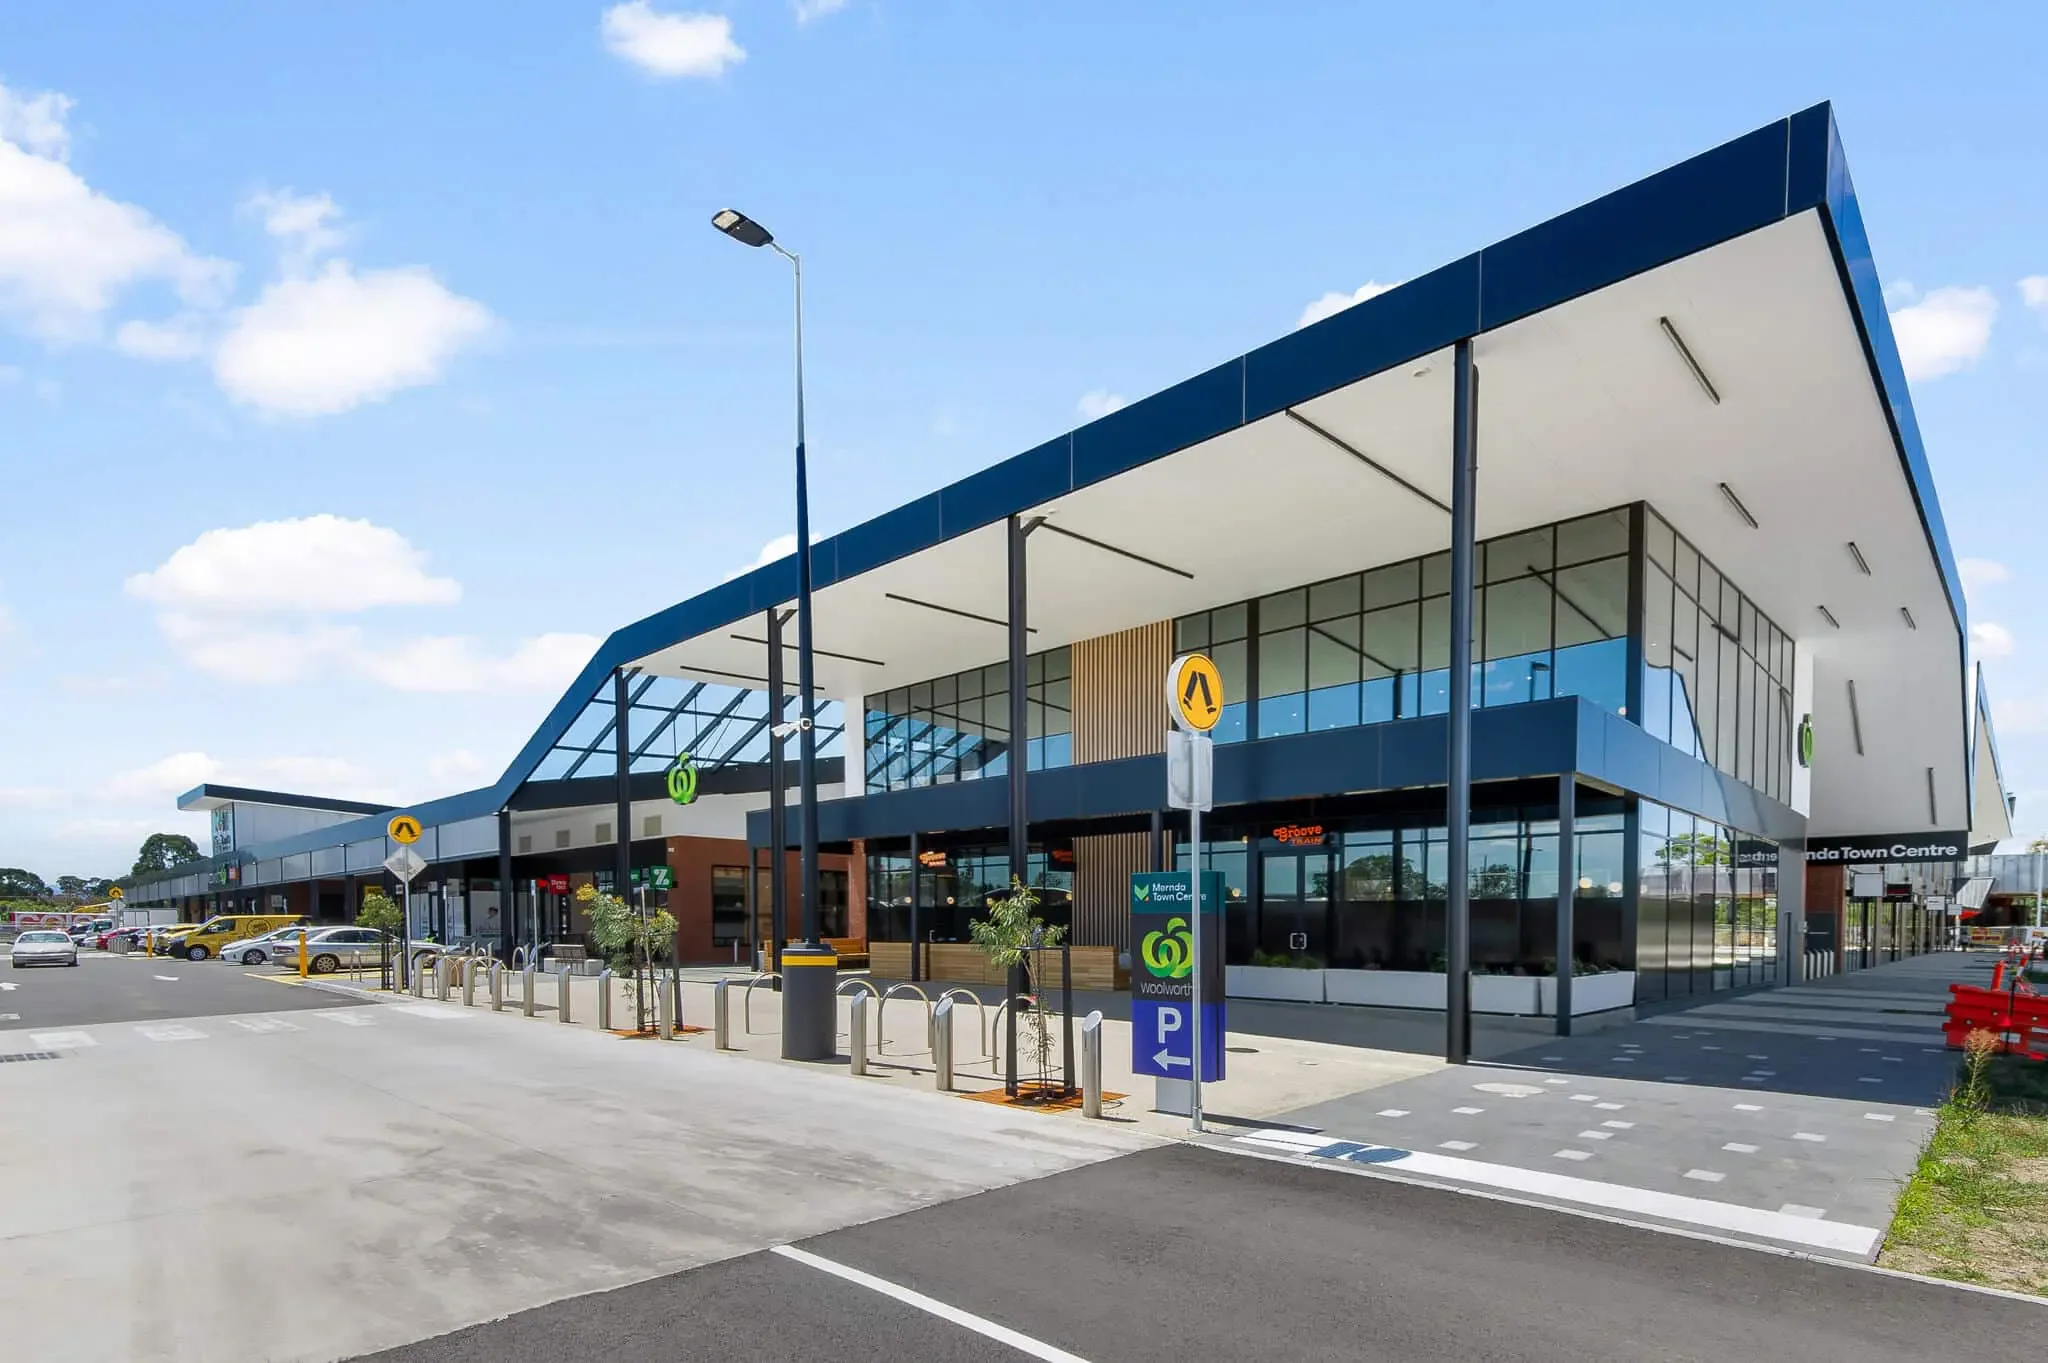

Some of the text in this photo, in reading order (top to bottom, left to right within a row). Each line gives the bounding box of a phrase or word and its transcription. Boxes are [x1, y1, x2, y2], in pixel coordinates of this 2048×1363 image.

[1806, 844, 1959, 860] nda Town Centre
[1152, 883, 1186, 892] Mernda
[1152, 892, 1175, 902] Town
[1157, 1006, 1182, 1044] P
